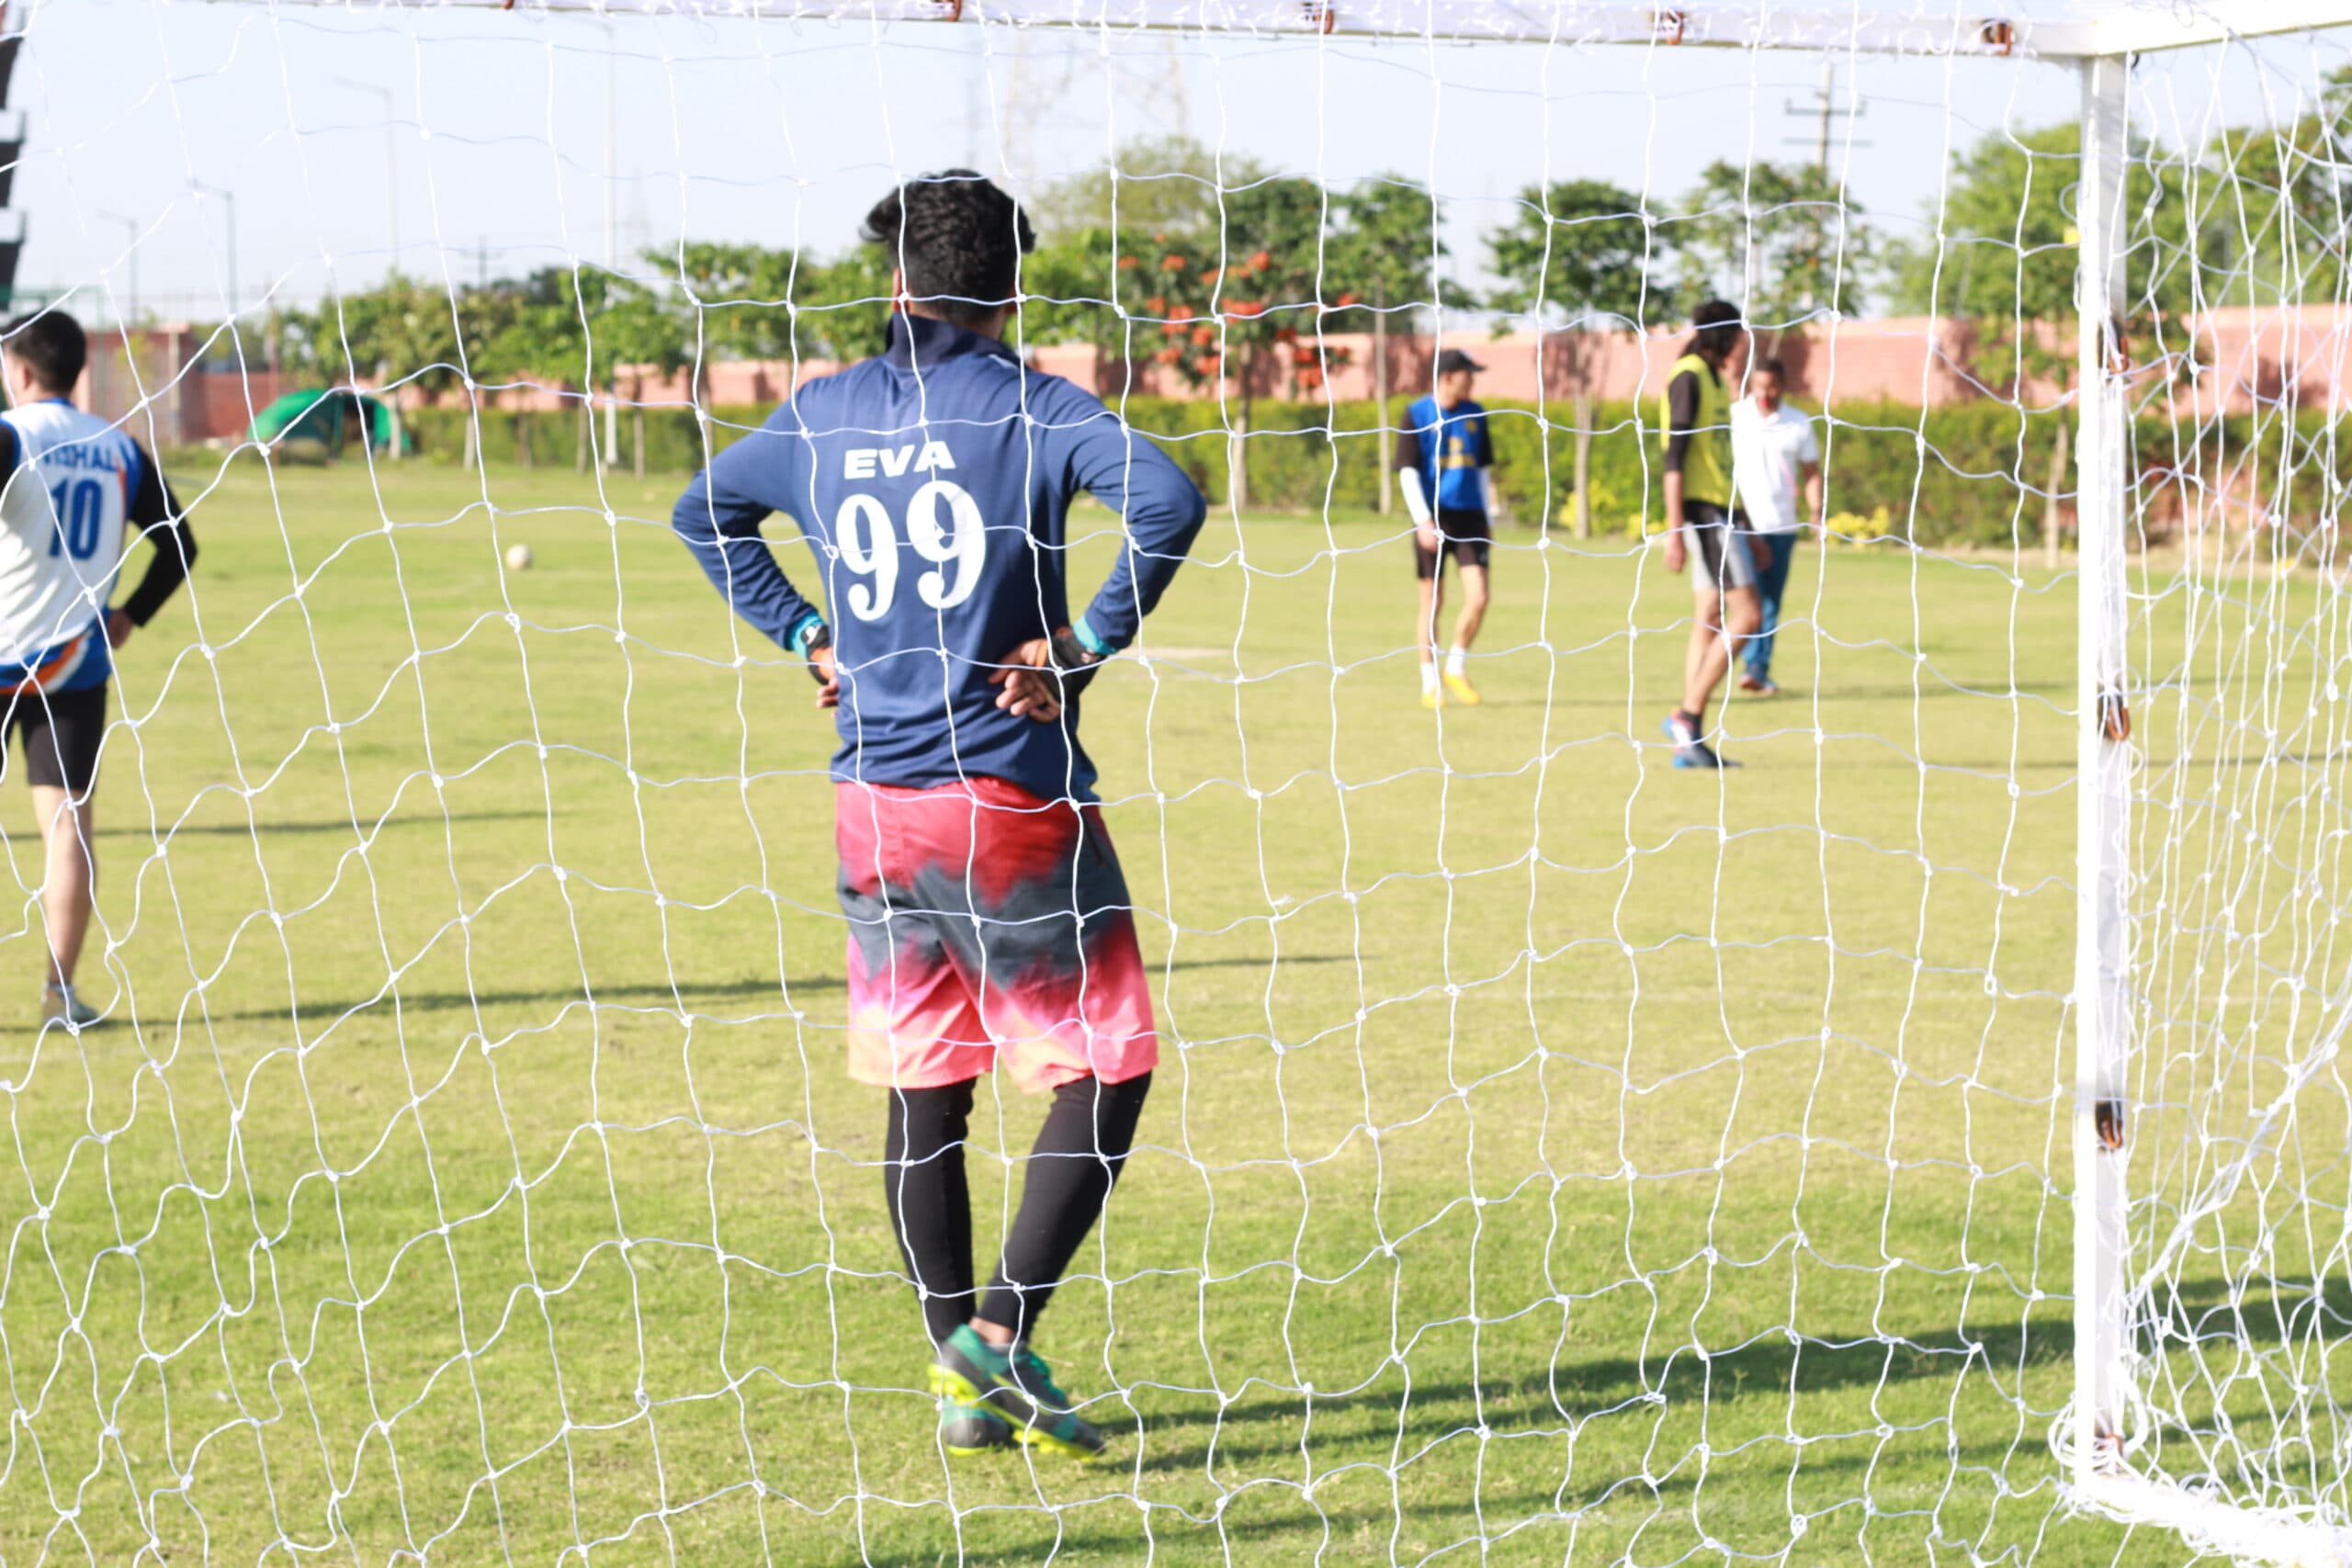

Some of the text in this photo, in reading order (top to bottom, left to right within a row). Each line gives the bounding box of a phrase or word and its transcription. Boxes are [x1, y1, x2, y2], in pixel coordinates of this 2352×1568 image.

[843, 441, 956, 479] EVA
[48, 477, 104, 561] 10
[835, 479, 987, 622] 99
